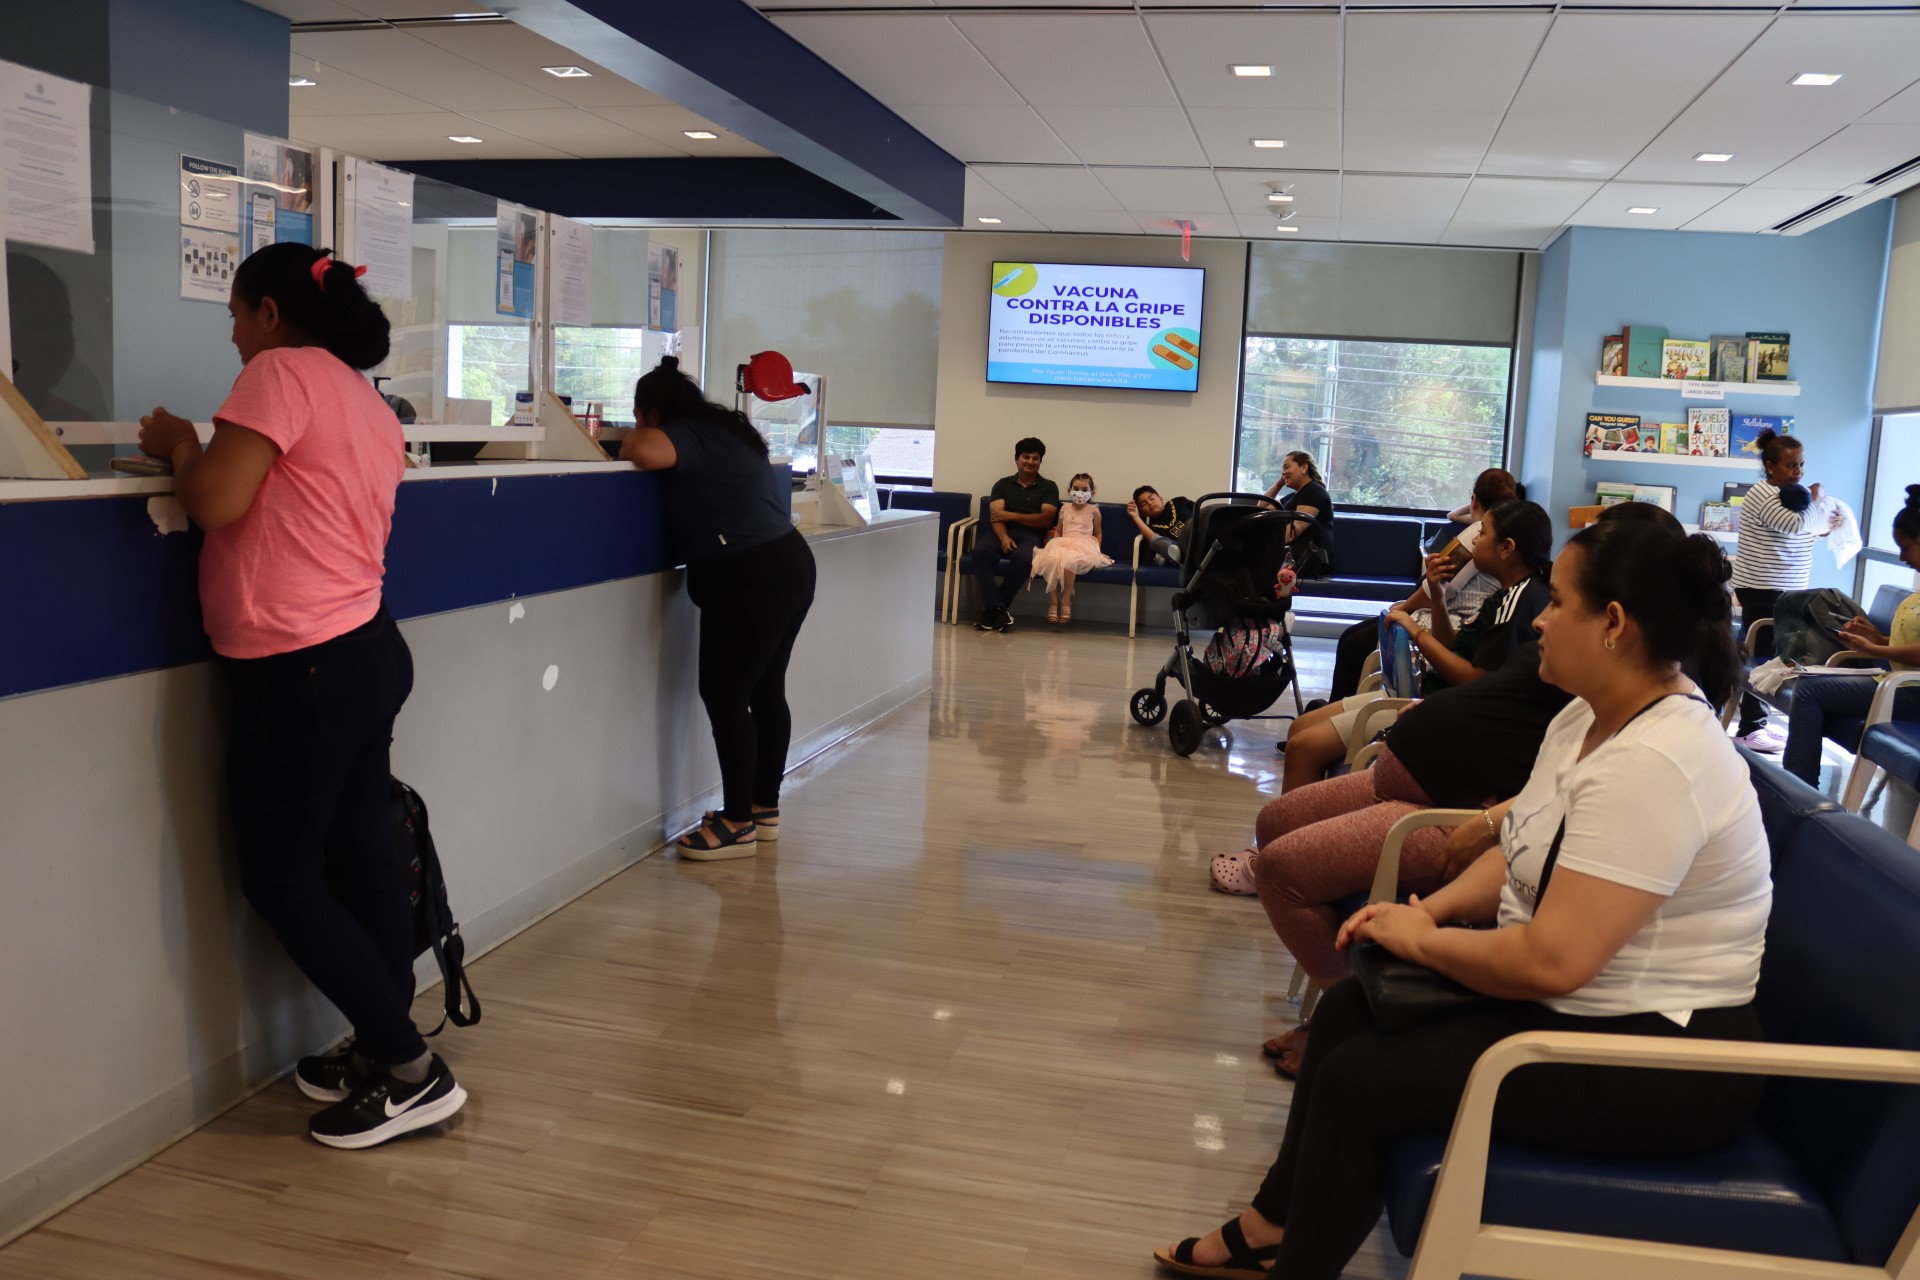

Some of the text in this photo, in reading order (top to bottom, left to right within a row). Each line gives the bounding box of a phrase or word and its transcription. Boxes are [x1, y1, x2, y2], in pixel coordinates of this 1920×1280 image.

[189, 162, 209, 171] FOLLOW
[1053, 285, 1139, 299] VACUNA
[1006, 298, 1185, 316] CONTRA LA GRIPE
[1029, 313, 1161, 329] DISPONIBLES
[1665, 349, 1704, 361] TINY
[1691, 414, 1727, 423] MODELS
[1705, 424, 1726, 433] AND
[1691, 434, 1726, 444] BOXES
